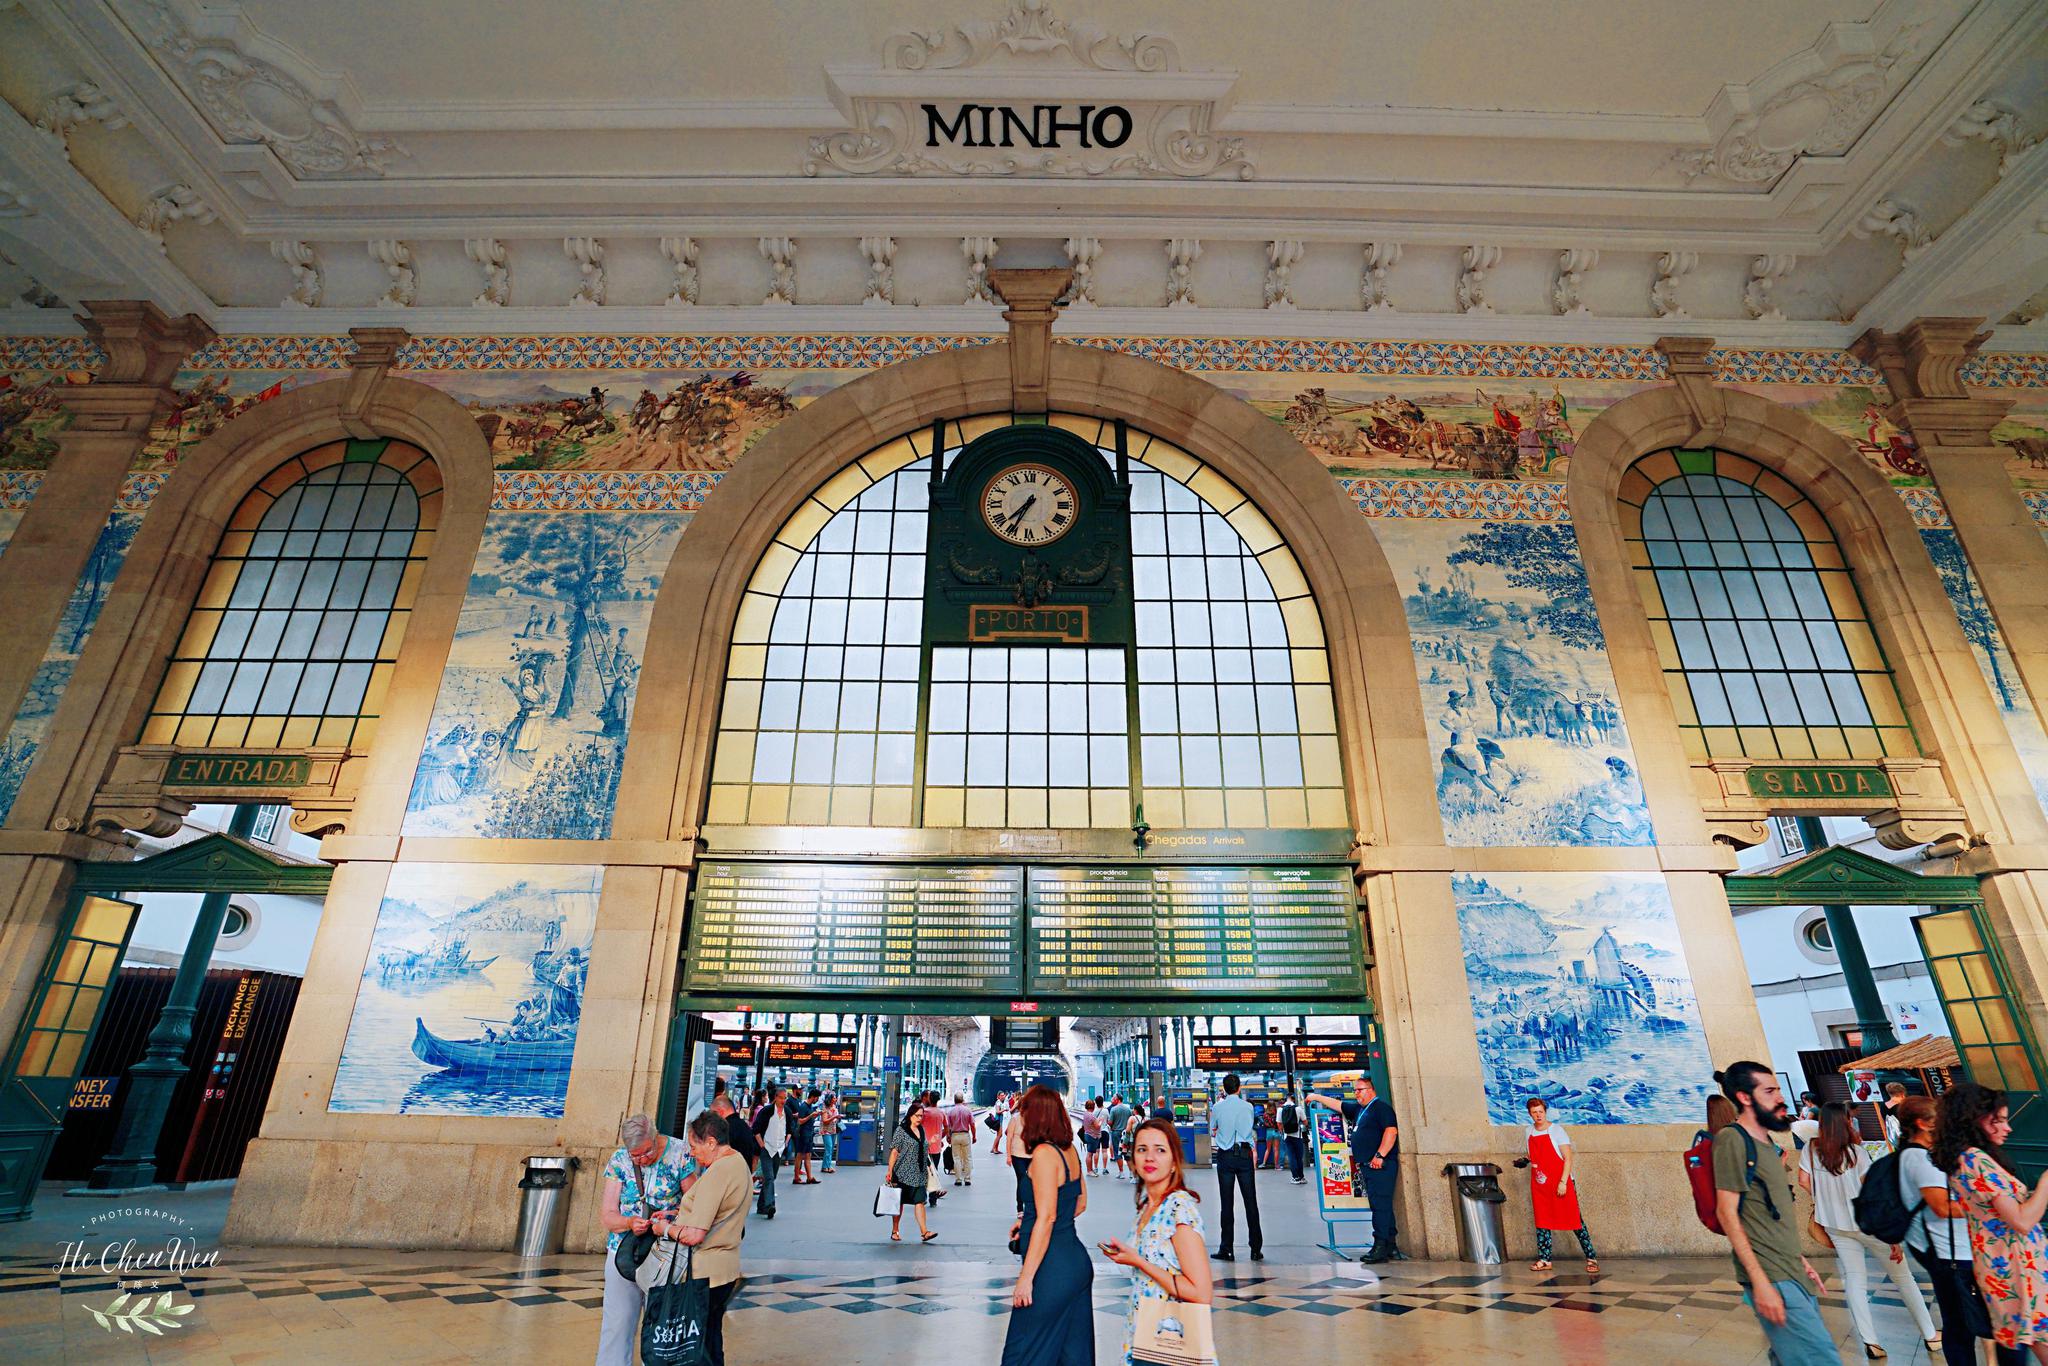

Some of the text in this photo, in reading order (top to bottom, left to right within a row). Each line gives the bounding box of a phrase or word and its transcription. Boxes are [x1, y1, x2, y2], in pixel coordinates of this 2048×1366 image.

[921, 104, 1133, 149] MINHO
[989, 611, 1069, 631] PORTO
[177, 759, 298, 783] ENTRADA
[1763, 771, 1873, 794] SAIDA
[1145, 834, 1245, 847] Chegadas Arrivals
[223, 976, 251, 1038] EXCHANGE
[234, 977, 262, 1039] EXCHANGE
[74, 1079, 109, 1093] NEY
